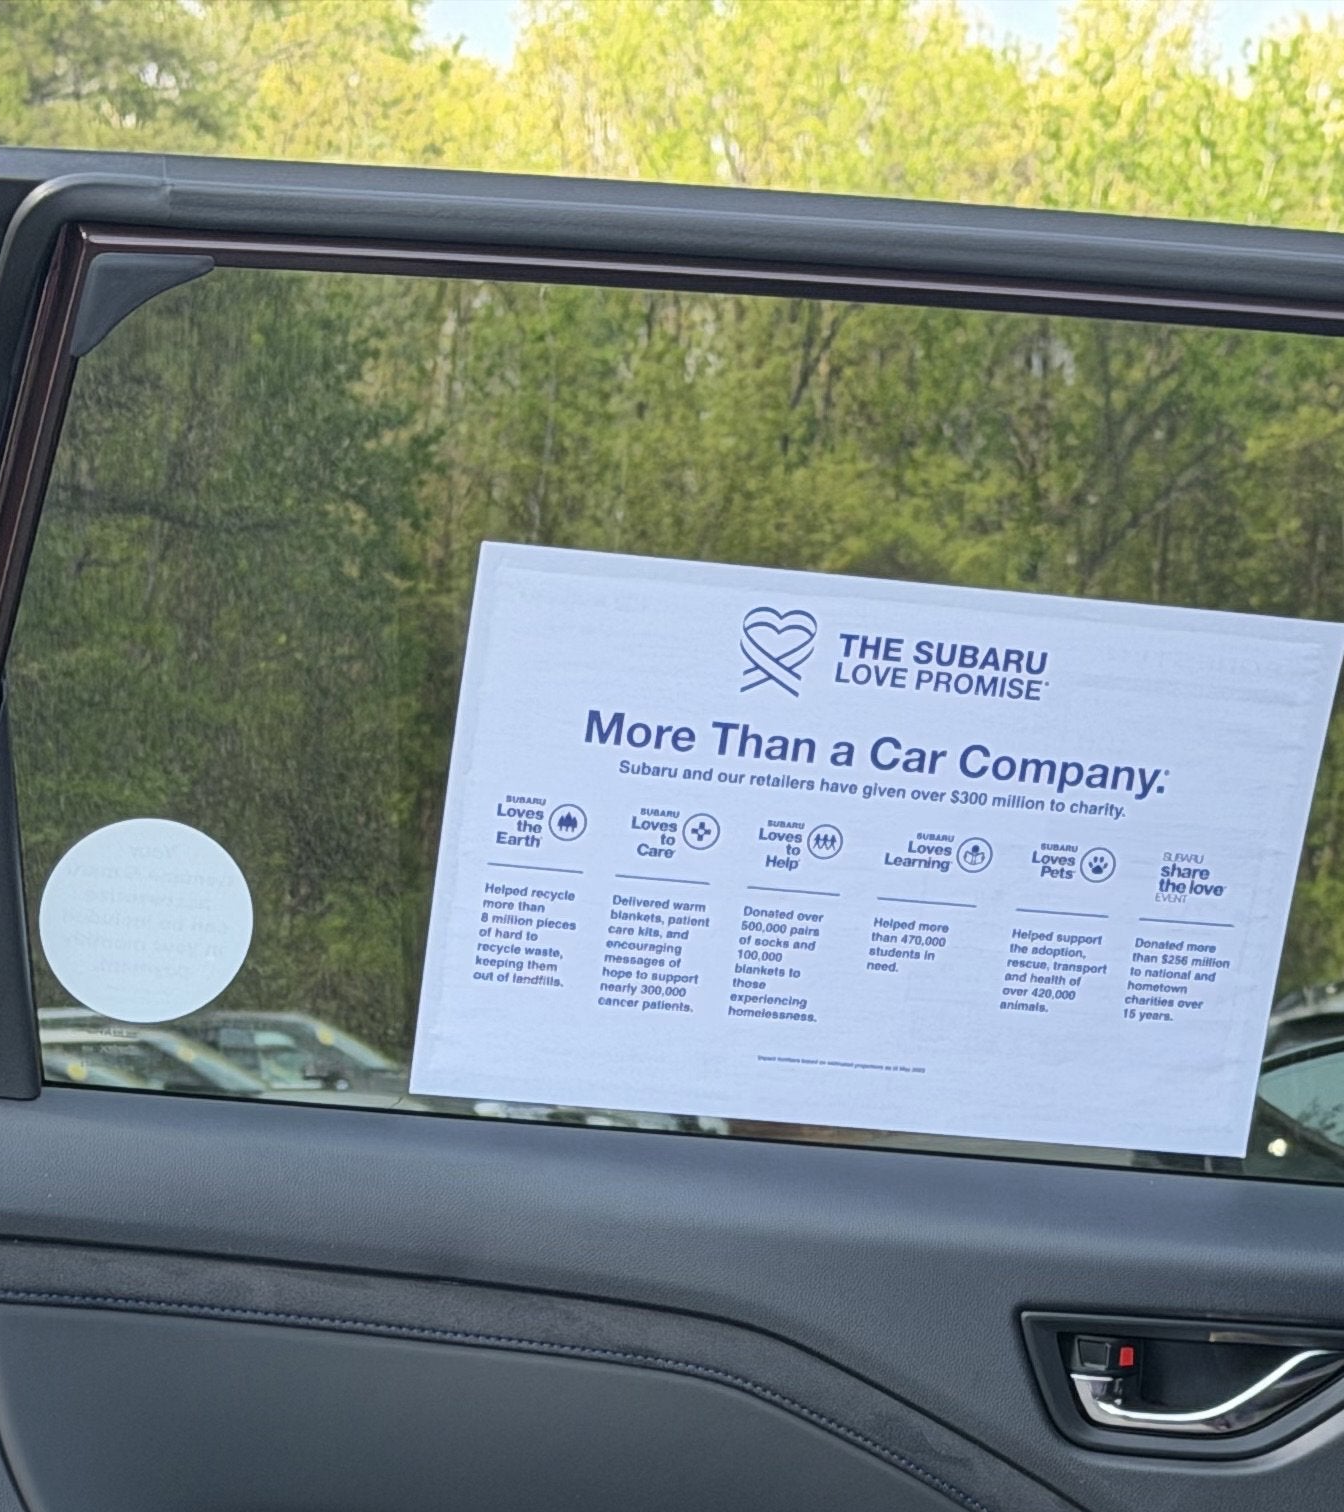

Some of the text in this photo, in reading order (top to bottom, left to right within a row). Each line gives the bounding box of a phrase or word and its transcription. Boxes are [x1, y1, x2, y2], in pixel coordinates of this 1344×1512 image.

[839, 633, 1048, 675] THE SUBARU
[835, 662, 909, 689] LOVE
[584, 710, 696, 752] More
[712, 721, 816, 763] Than
[830, 741, 854, 767] a
[870, 736, 947, 775] Car
[618, 759, 1126, 820] Subaru and our retailers have given over $300 million to charity.
[506, 795, 547, 806] SUBARU
[497, 803, 545, 820] Loves
[640, 807, 680, 819] SUBARU
[516, 818, 542, 834] the
[631, 815, 678, 832] Loves
[767, 819, 806, 830] SUBARU
[496, 831, 541, 848] Earth
[660, 832, 676, 846] to
[758, 827, 803, 844] Loves
[916, 832, 955, 843] SUBARU
[636, 843, 674, 859] Care
[785, 843, 801, 856] to
[907, 840, 953, 857] Loves
[1040, 842, 1079, 853] SUBARU
[765, 854, 799, 872] Help
[884, 852, 950, 873] Learning
[1031, 850, 1076, 867] Loves
[1162, 851, 1205, 864] SUBARU
[1040, 865, 1074, 880] Pets
[1160, 863, 1211, 881] share
[484, 882, 576, 902] Helped recycle
[1158, 878, 1224, 897] the love
[482, 899, 546, 914] more than
[612, 894, 707, 913] Delivered warm
[491, 914, 534, 927] million
[535, 917, 577, 931] pieces
[610, 908, 711, 928] blankets, patient
[743, 905, 825, 923] Donated over
[607, 925, 690, 940] care kits, and
[789, 925, 820, 937] pairs
[873, 916, 950, 934] Helped more
[478, 926, 539, 942] of hard to
[871, 931, 898, 944] than
[1011, 928, 1103, 947] Helped support
[476, 942, 564, 960] recycle waste,
[605, 939, 683, 957] encouraging
[738, 934, 817, 952] of socks and
[1009, 943, 1087, 960] the adoption,
[1134, 937, 1217, 954] Donated more
[603, 953, 682, 969] messages of
[868, 946, 936, 961] students in
[1132, 952, 1159, 964] than
[1190, 956, 1231, 969] million
[475, 954, 558, 972] keeping them
[734, 962, 801, 979] blankets to
[866, 961, 899, 973] need.
[1006, 958, 1108, 976] rescue, transport
[472, 971, 564, 988] out of landfills.
[601, 966, 699, 985] hope to support
[1004, 972, 1082, 987] and health of
[1129, 966, 1217, 983] to national and
[599, 982, 638, 997] nearly
[732, 977, 767, 990] those
[1001, 987, 1029, 997] over
[1126, 979, 1188, 995] hometown
[597, 996, 694, 1013] cancer patients.
[729, 993, 808, 1010] experiencing
[999, 999, 1049, 1013] animals.
[1124, 994, 1204, 1010] charities over
[727, 1005, 818, 1023] homelessness.
[1138, 1011, 1174, 1022] years.
